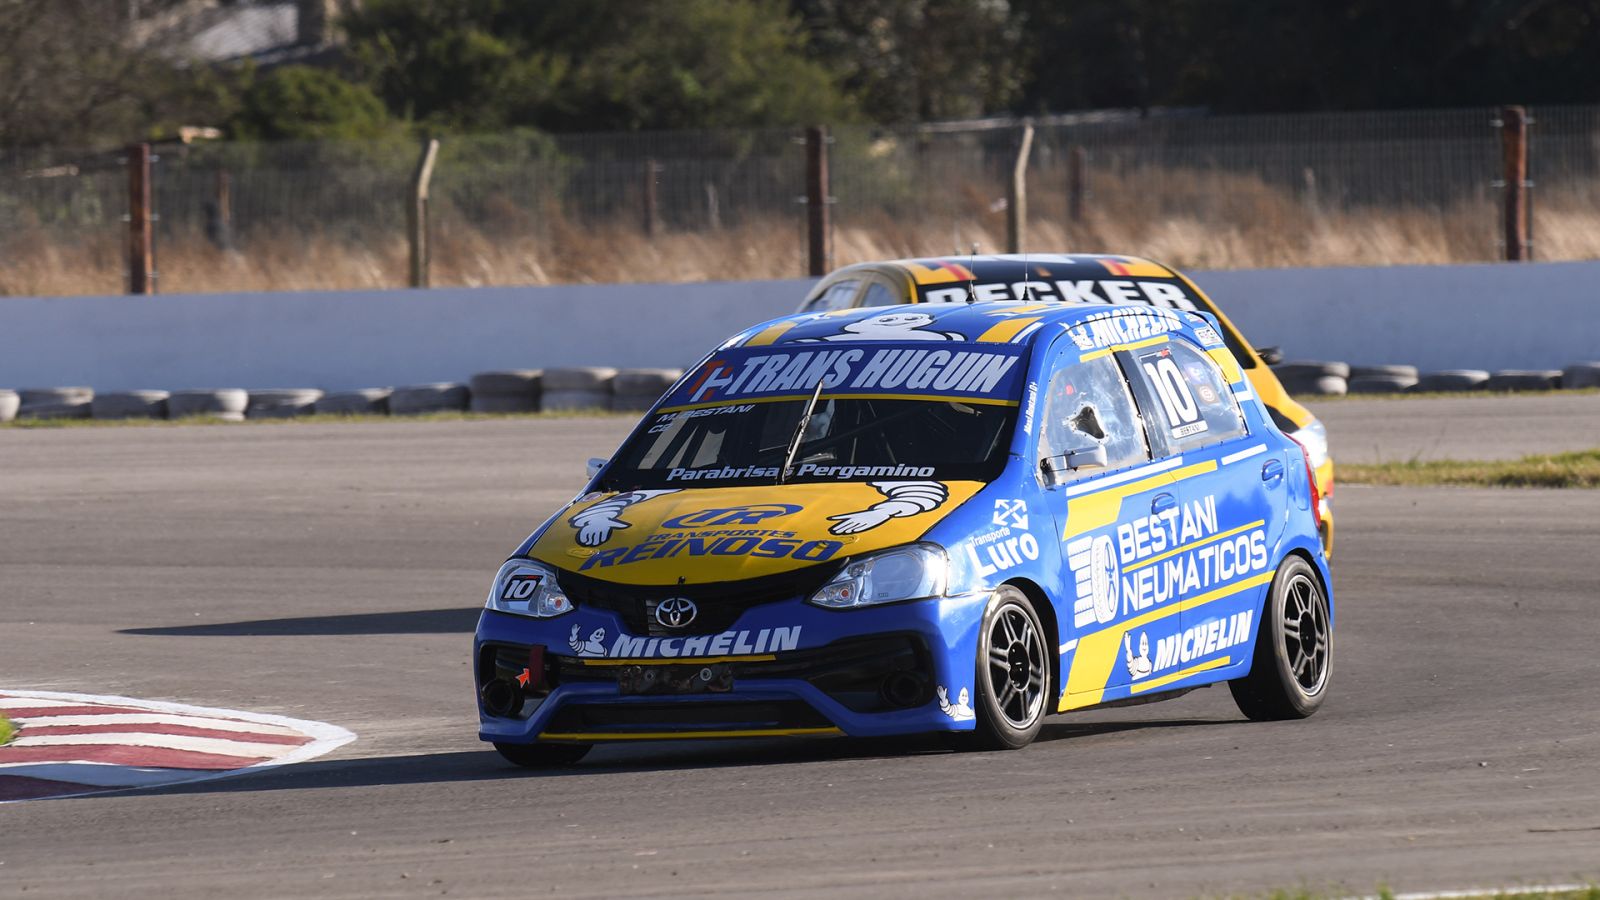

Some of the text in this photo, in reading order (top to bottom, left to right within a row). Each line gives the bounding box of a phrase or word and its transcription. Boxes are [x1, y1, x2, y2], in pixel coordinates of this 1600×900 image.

[1087, 306, 1182, 348] MICHELIN
[725, 350, 1019, 395] TRANS HUGUIN
[682, 404, 756, 418] BESTANI
[1143, 358, 1199, 427] 10
[666, 464, 935, 481] Parabrisas Pergamino
[646, 529, 797, 541] TRANSPORTES
[968, 527, 1011, 548] Transporte
[1116, 496, 1218, 564] BESTANI
[580, 537, 844, 570] REINOSO
[965, 532, 1040, 580] Luro
[1121, 529, 1268, 615] NEUMATICOS
[503, 579, 537, 599] 10
[609, 626, 802, 658] MICHELIN
[1153, 610, 1253, 672] MICHELIN
